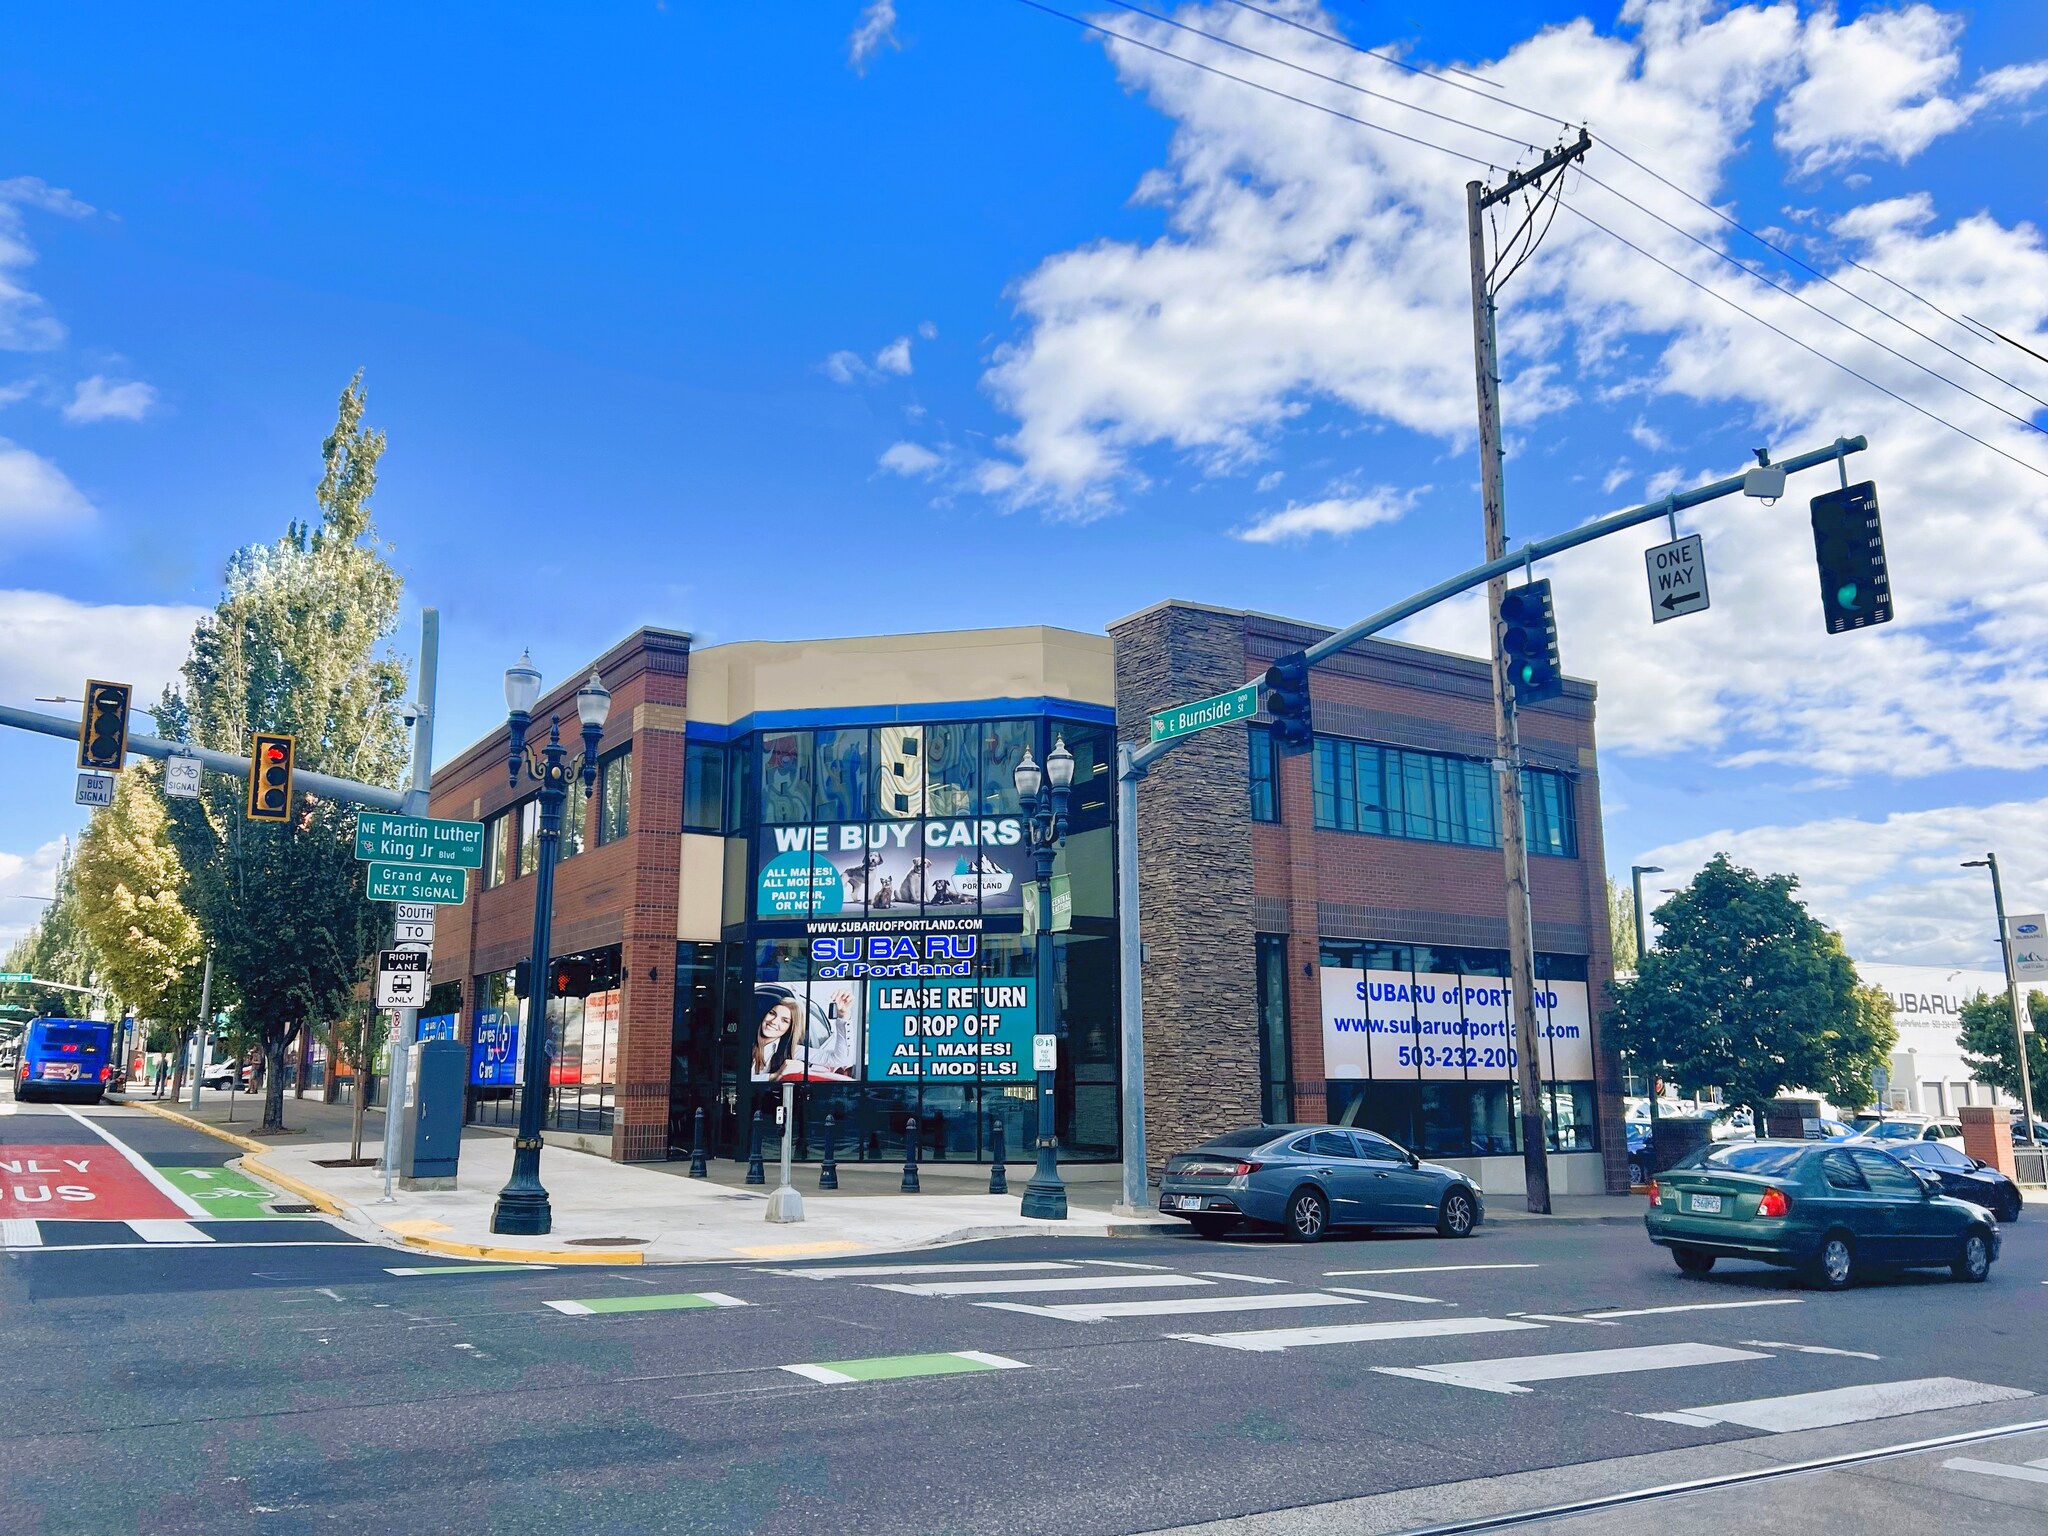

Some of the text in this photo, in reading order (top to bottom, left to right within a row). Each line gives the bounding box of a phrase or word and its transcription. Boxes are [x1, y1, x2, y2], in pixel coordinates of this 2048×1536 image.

[1656, 545, 1693, 569] ONE
[1658, 566, 1694, 591] WAY
[1169, 700, 1244, 731] E Burnside St
[87, 778, 104, 790] BUS
[168, 781, 197, 791] SIGNAL
[78, 790, 108, 803] SIGNAL
[361, 821, 480, 843] NE Martin Luther
[774, 819, 1021, 852] WE BUY CARS
[380, 840, 456, 860] King Jr Blvd
[382, 868, 453, 884] Grand Ave
[766, 867, 833, 877] ALL MAKES!
[763, 877, 836, 888] ALL MODELS!
[373, 884, 459, 899] NEXT SIGNAL
[771, 891, 797, 900] PAID
[398, 905, 433, 919] SOUTH
[776, 901, 822, 910] OR NOT!
[406, 926, 424, 938] TO
[806, 919, 983, 933] WWW.SUBARUOFPORTLAND.COM
[388, 953, 420, 961] RIGHT
[819, 960, 971, 978] of Portland
[879, 986, 1026, 1009] LEASE RETURN
[1356, 982, 1557, 1009] SUBARU of PORTND
[1886, 992, 1958, 1015] UBARU
[904, 1014, 1000, 1036] DROP OFF
[893, 1042, 1011, 1056] ALL MAKES!
[1398, 1045, 1518, 1067] 503-232-200
[887, 1061, 1018, 1075] ALL MODELS!
[0, 1160, 90, 1173] NLY
[0, 1186, 96, 1202] US
